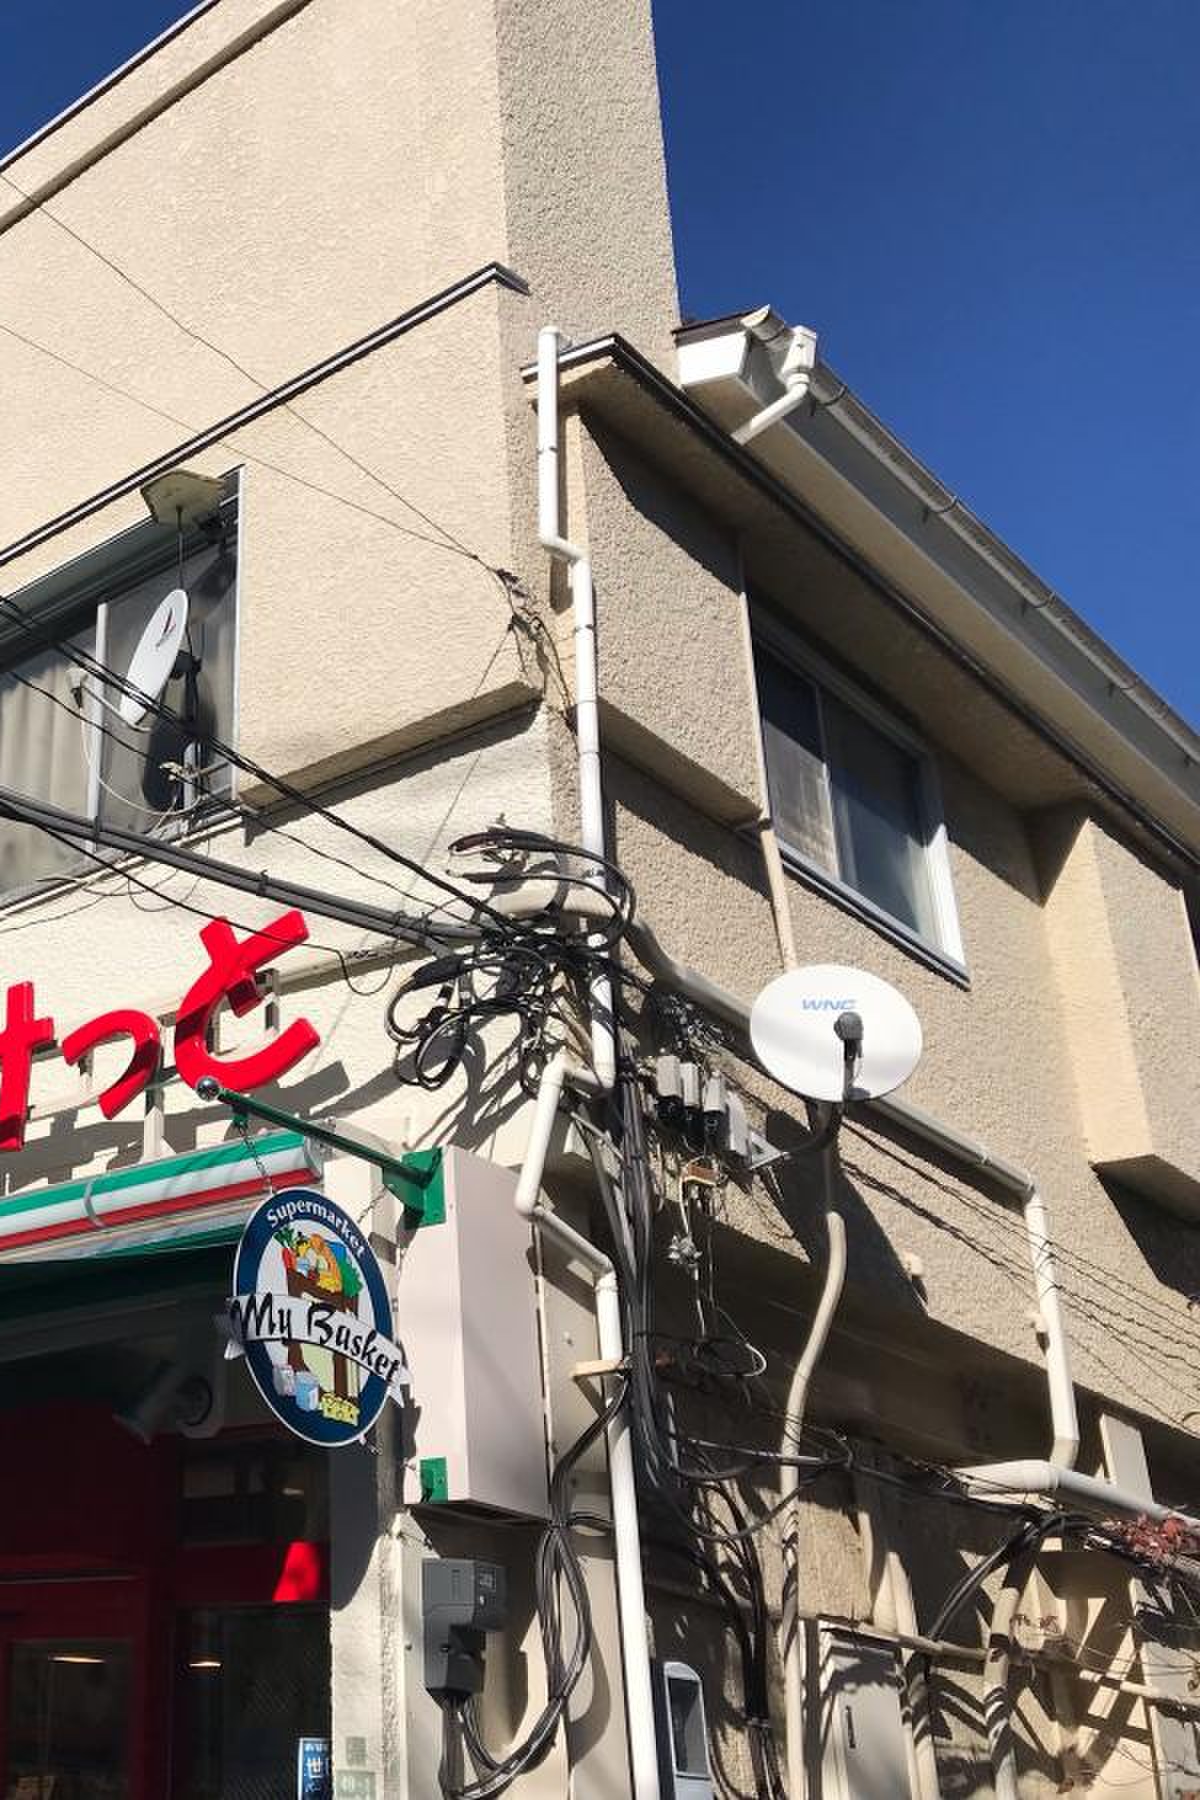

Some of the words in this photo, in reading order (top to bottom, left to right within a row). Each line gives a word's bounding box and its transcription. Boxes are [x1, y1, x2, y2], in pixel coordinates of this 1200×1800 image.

[802, 999, 857, 1010] WNC
[267, 1200, 365, 1257] Supermarket
[229, 1293, 292, 1344] My
[307, 1301, 401, 1382] Basket
